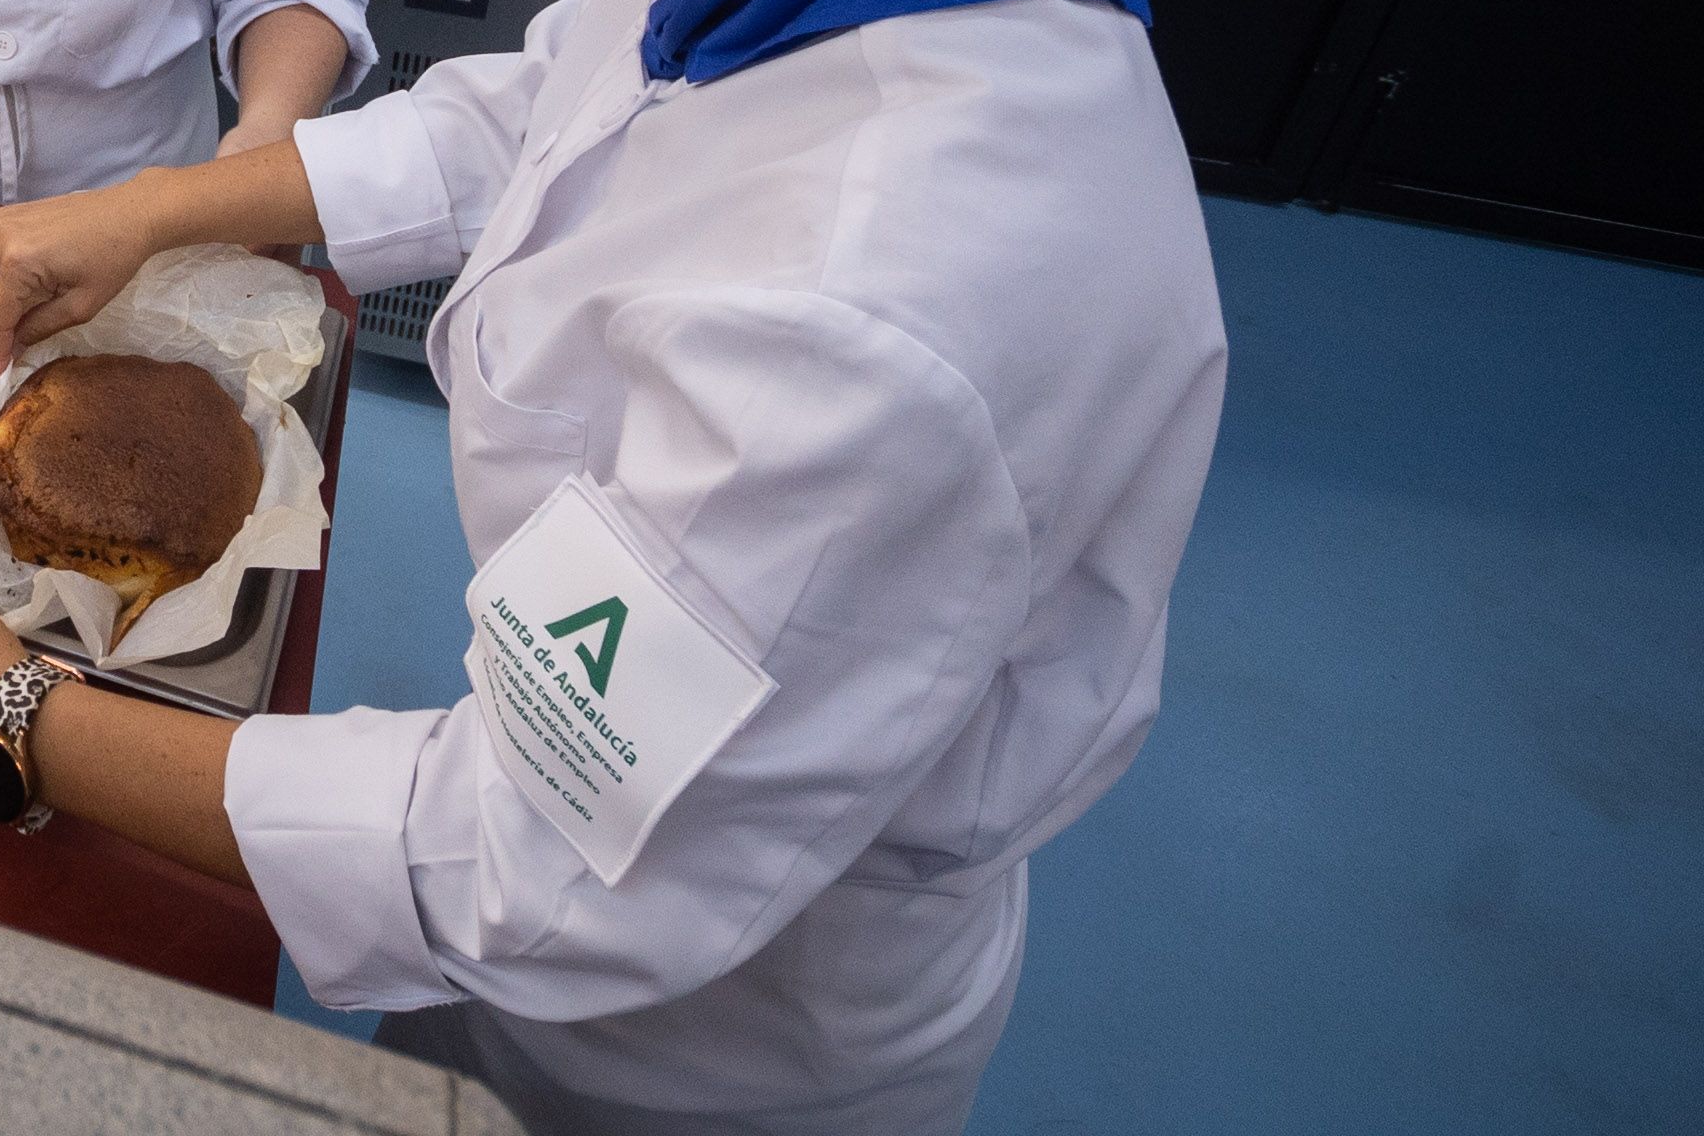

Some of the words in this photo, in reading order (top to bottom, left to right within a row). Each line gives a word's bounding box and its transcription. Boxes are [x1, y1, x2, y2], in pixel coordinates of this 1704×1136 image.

[480, 613, 523, 671] Consejería
[523, 670, 536, 687] de
[535, 684, 575, 735] Empleo,
[576, 730, 623, 784] Empresa
[490, 596, 534, 649] Junta
[534, 647, 556, 674] de
[552, 671, 638, 768] Andalucía
[500, 661, 534, 706] Trabajo
[533, 705, 587, 764] Autónomo
[505, 692, 544, 739] Andaluz
[543, 737, 558, 753] de
[558, 751, 601, 795] Empleo
[545, 776, 561, 792] de
[561, 790, 594, 823] Cádiz
